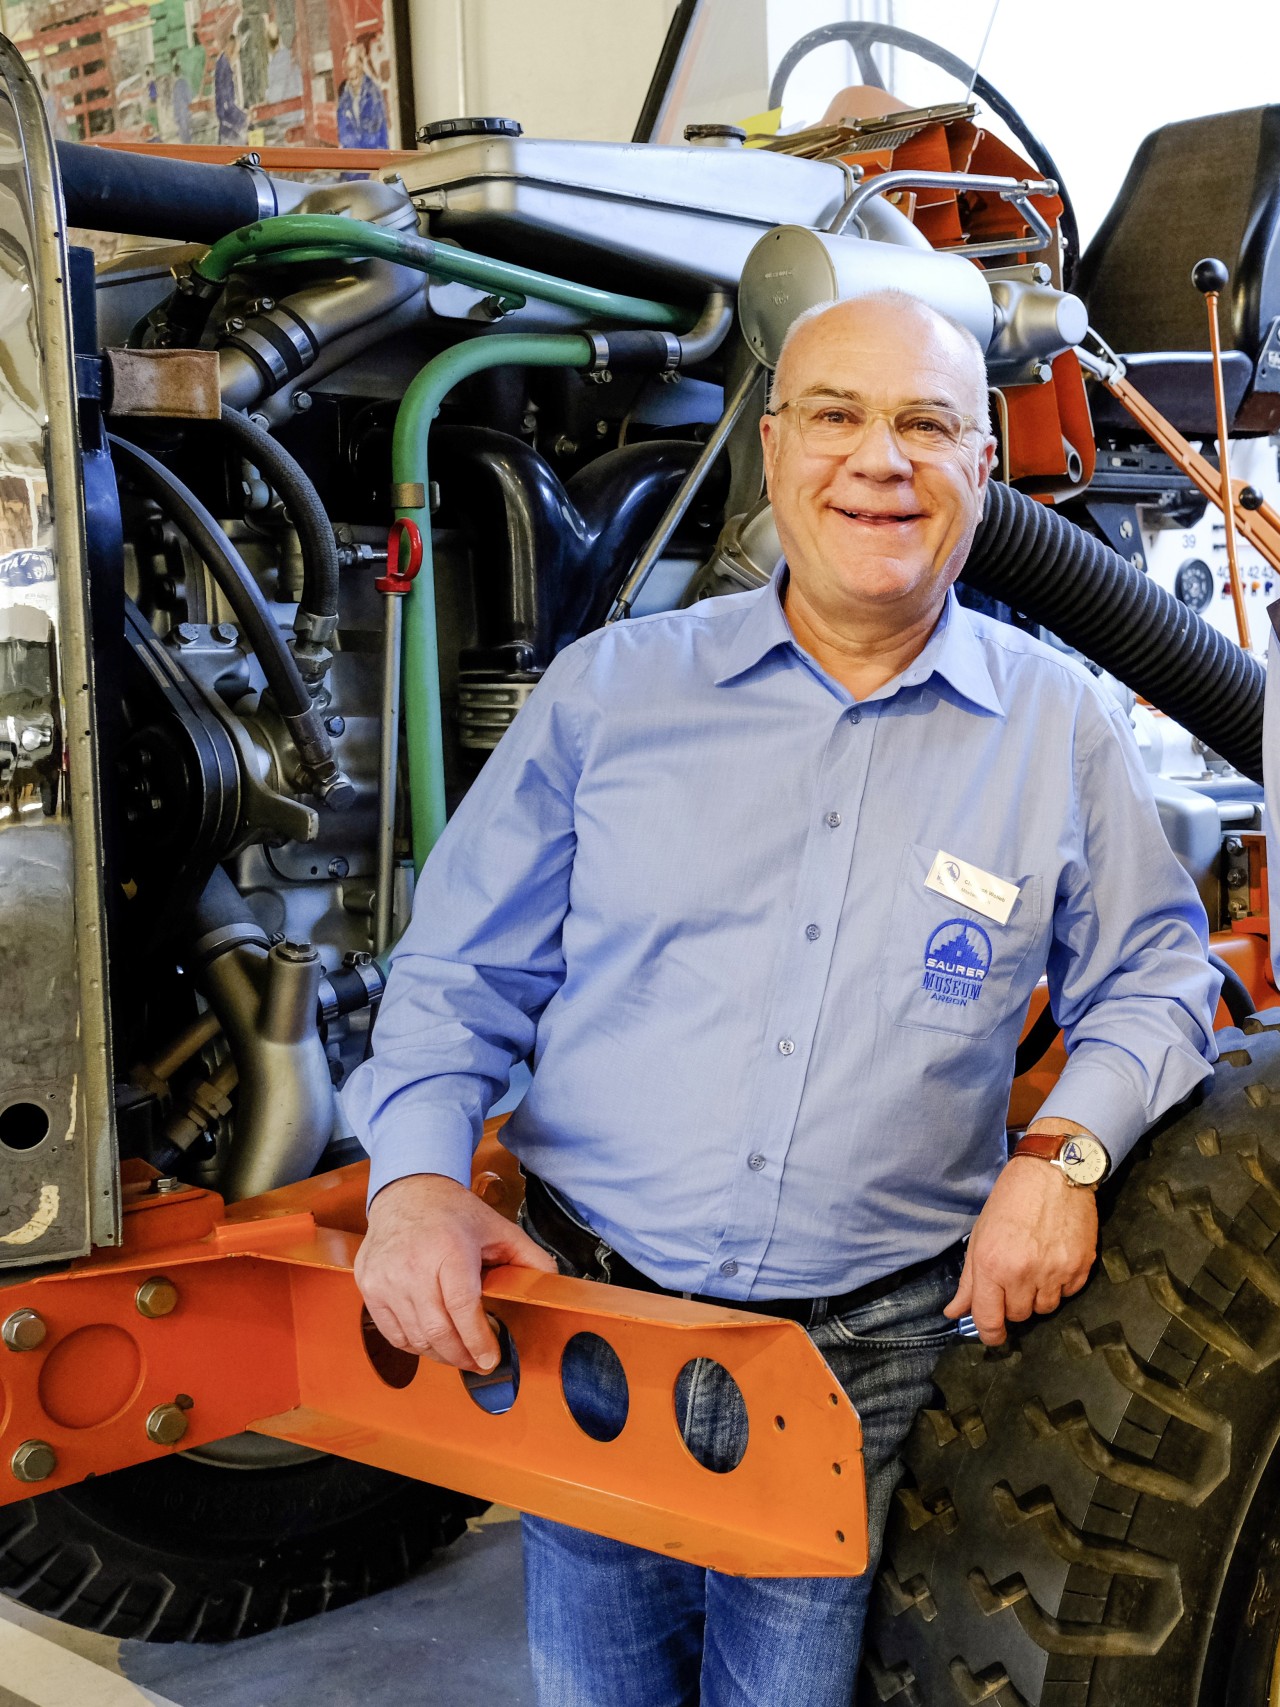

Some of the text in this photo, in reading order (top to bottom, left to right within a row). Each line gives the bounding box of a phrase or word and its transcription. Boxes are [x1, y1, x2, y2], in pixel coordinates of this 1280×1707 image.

[1182, 534, 1196, 549] 39
[1247, 565, 1260, 579] 42
[926, 957, 985, 979] SAURER
[921, 971, 982, 1000] MUSEUM
[931, 992, 967, 1007] ARBON
